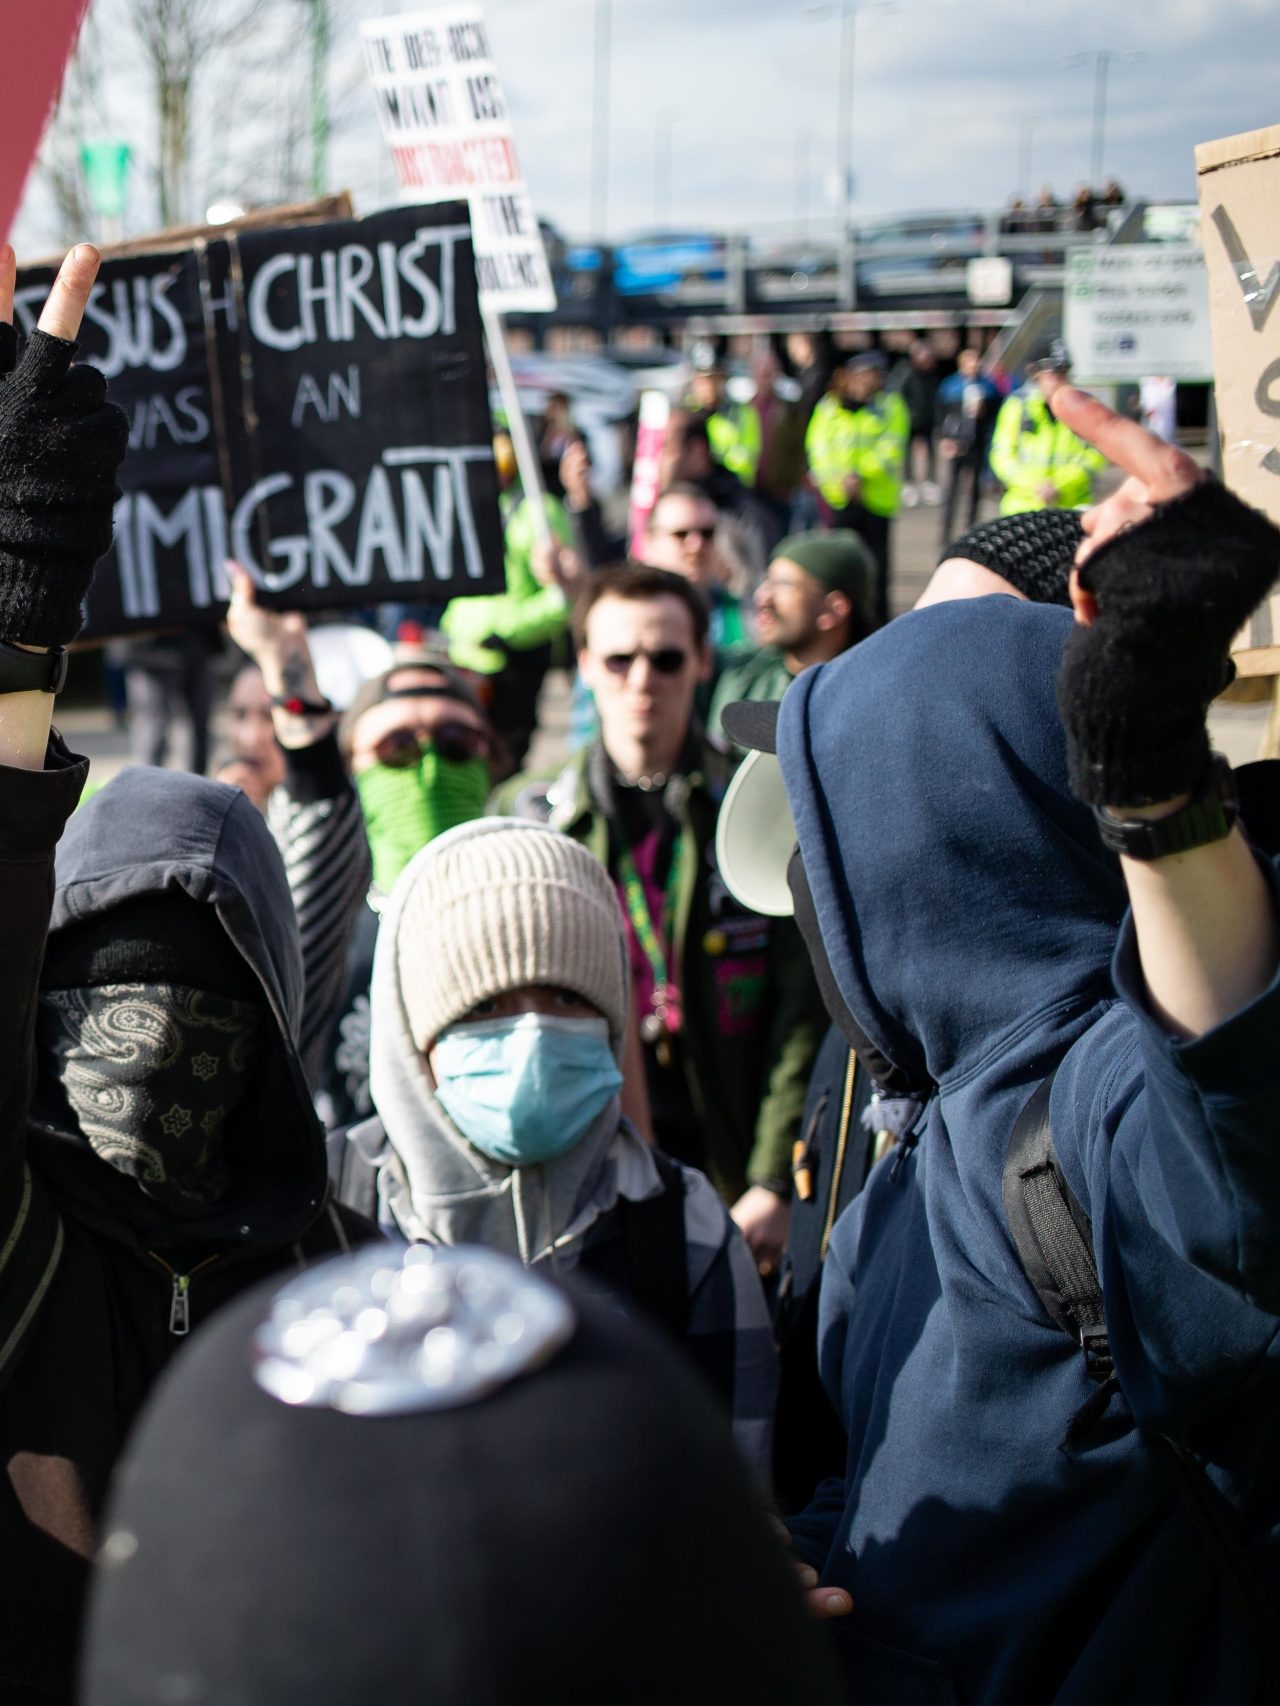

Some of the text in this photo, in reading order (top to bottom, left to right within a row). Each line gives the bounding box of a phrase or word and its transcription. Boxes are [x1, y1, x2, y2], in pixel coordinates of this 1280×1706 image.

[14, 266, 187, 379] SUS
[248, 224, 473, 351] CHRIST
[291, 364, 362, 428] AN
[80, 445, 495, 630] MIGRANT
